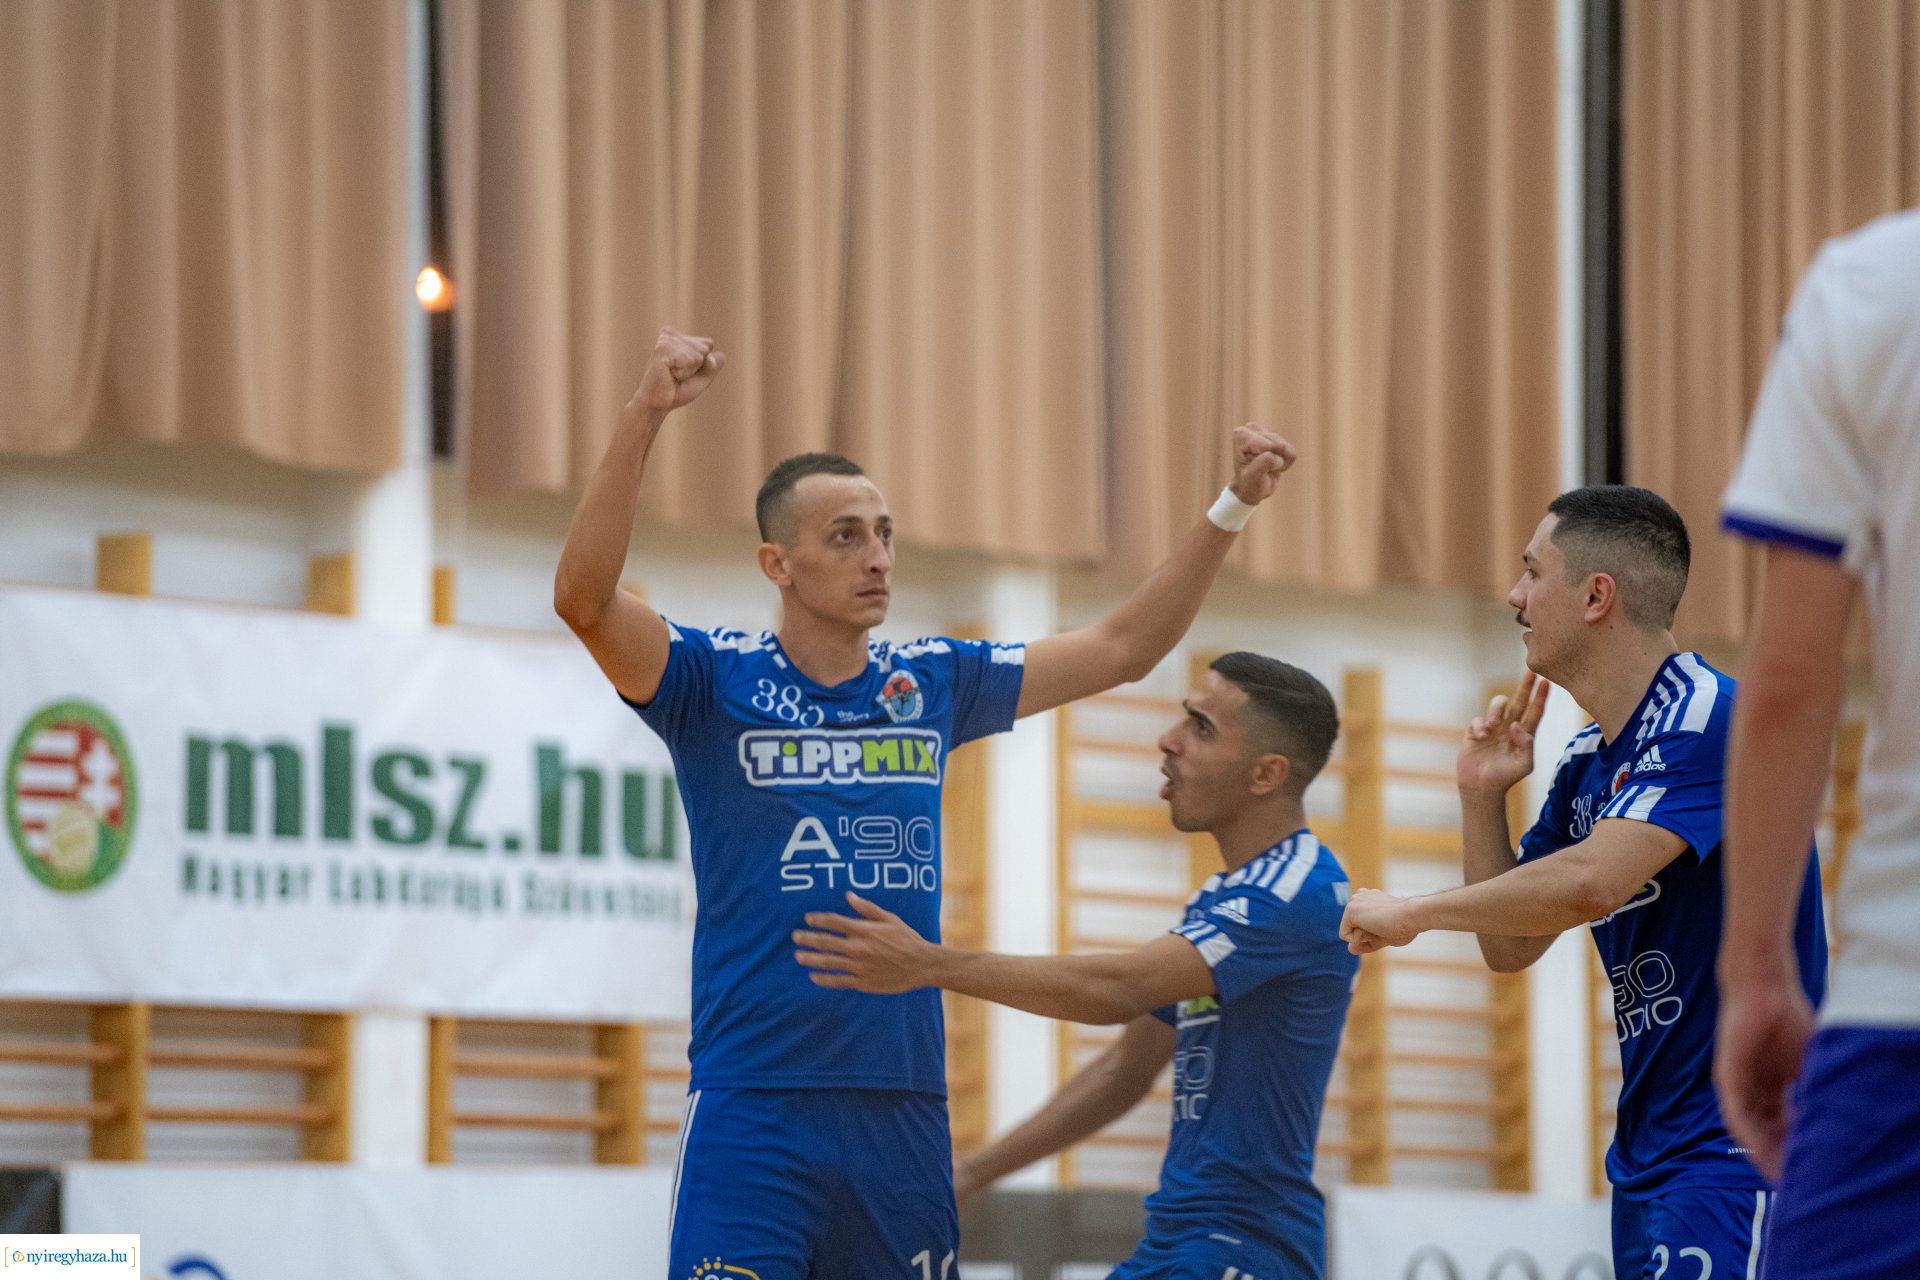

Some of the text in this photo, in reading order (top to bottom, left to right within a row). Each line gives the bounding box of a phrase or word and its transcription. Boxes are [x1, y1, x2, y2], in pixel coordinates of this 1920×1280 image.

[183, 718, 679, 864] mlsz.hu
[779, 815, 936, 862] A'90
[780, 862, 937, 893] STUDIO
